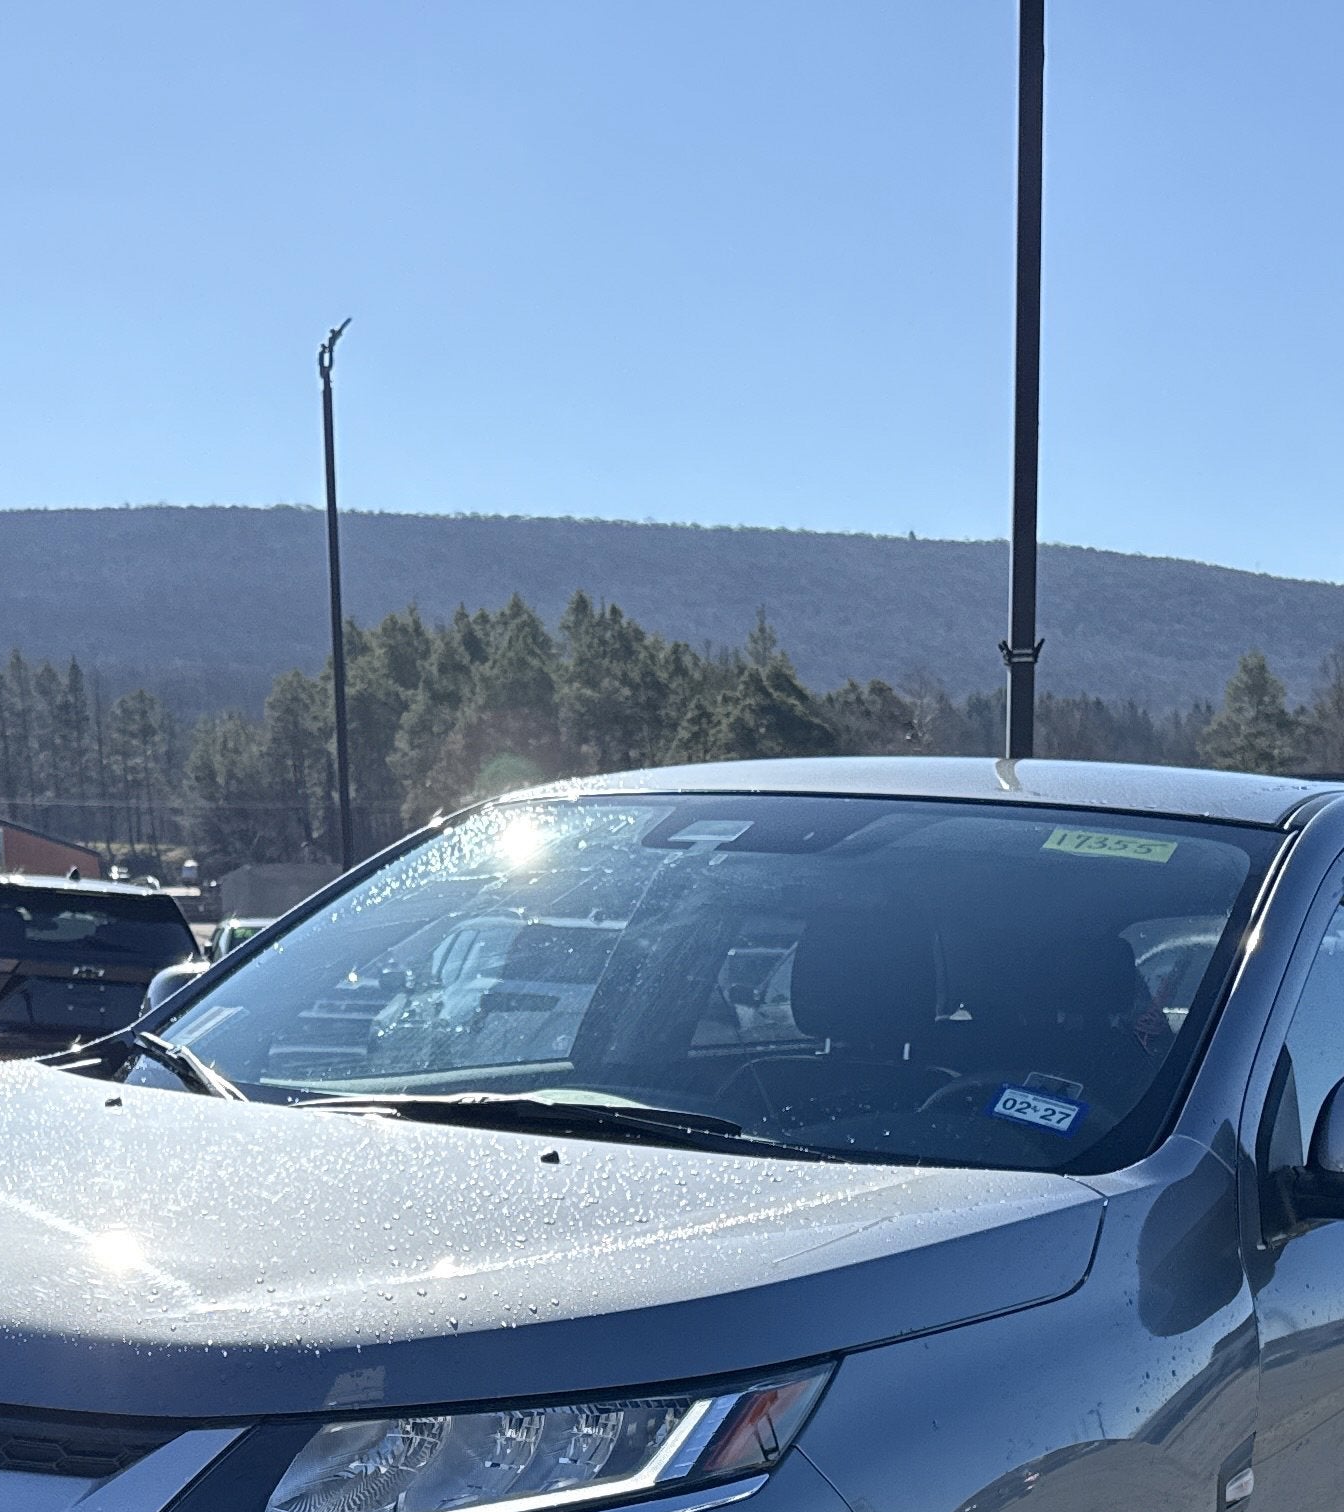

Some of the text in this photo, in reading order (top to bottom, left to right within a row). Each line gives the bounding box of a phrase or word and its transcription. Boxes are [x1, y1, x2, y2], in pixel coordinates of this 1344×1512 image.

[1057, 832, 1168, 855] 17355
[1002, 1097, 1032, 1115] 02
[1039, 1107, 1072, 1125] 27
